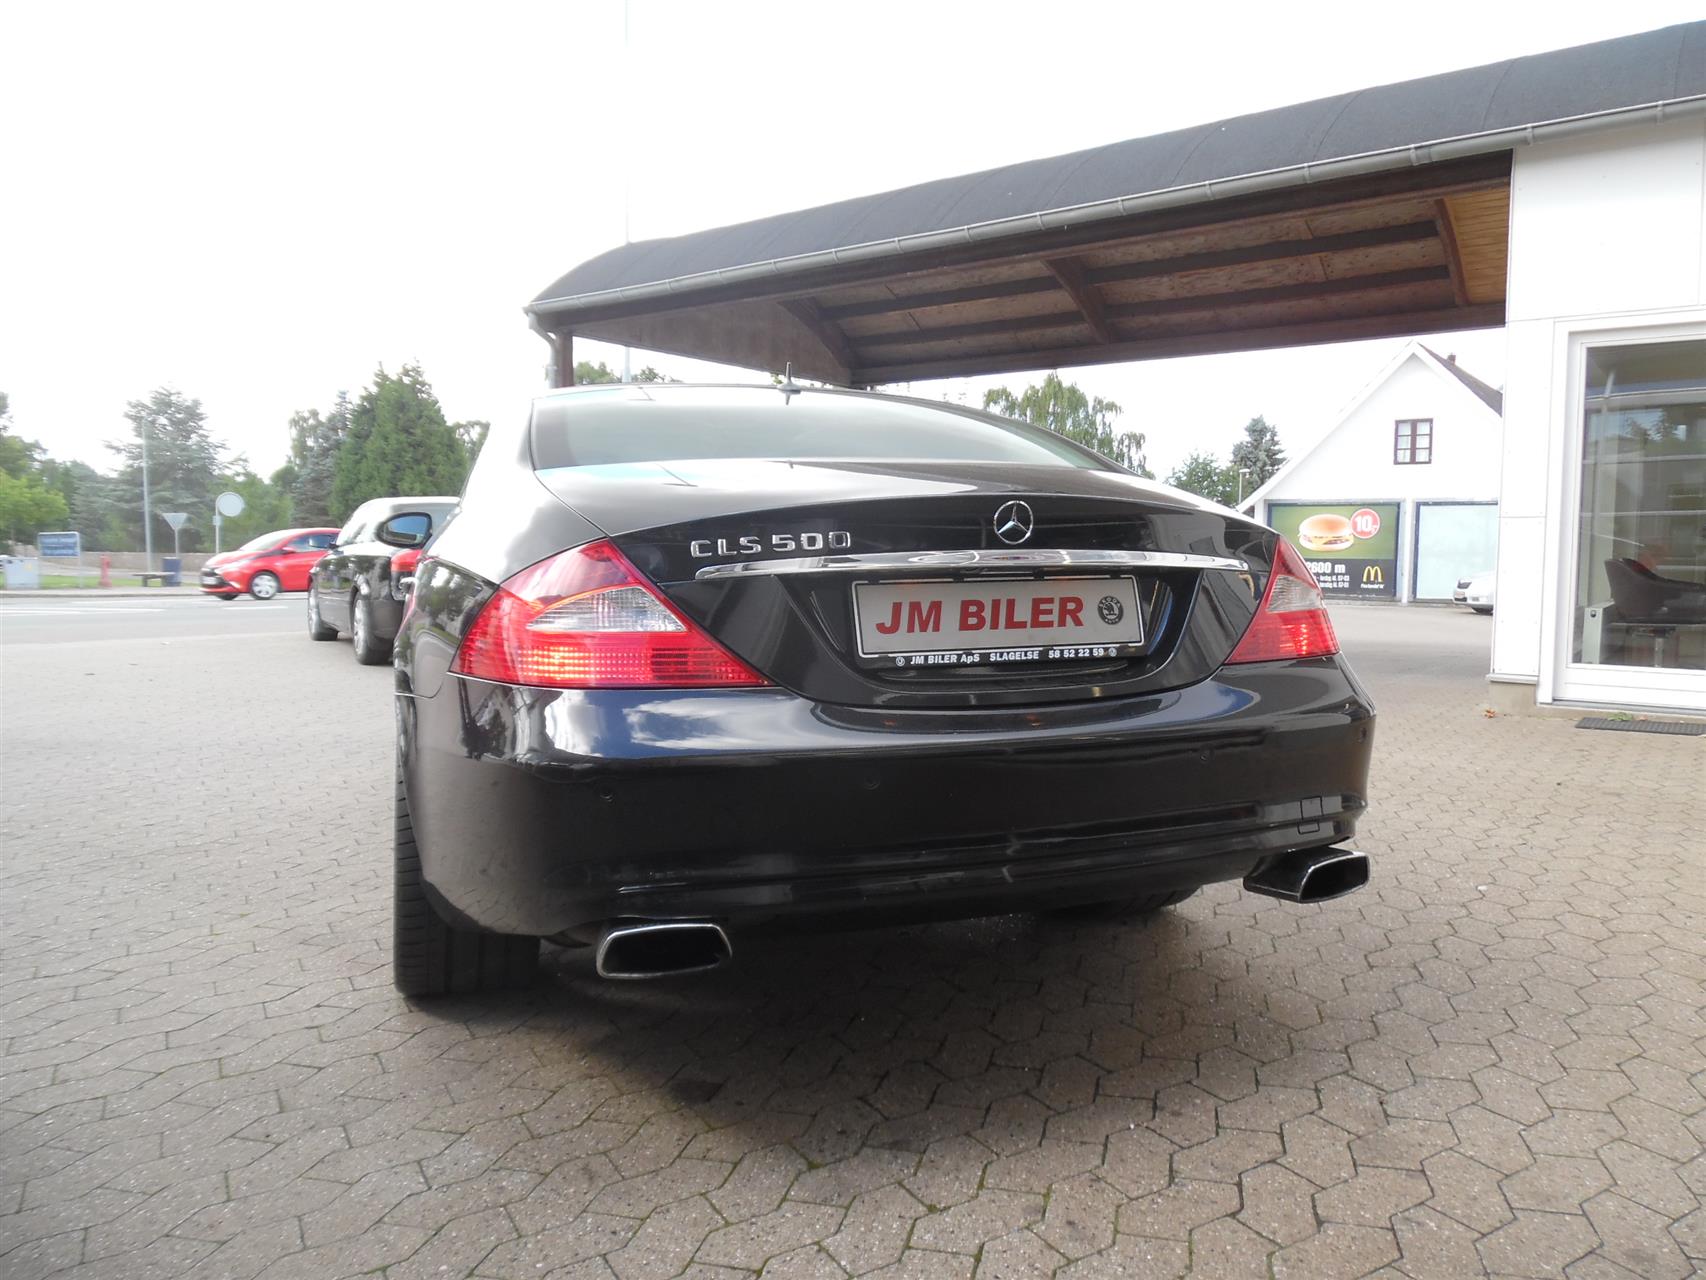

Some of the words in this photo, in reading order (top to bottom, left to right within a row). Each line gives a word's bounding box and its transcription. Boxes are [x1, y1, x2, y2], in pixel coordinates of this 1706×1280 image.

[690, 536, 762, 558] CLS
[771, 531, 851, 552] 500
[1334, 564, 1346, 573] m
[875, 600, 942, 635] JM
[958, 596, 1084, 631] BILER
[910, 655, 924, 665] JM
[927, 654, 958, 664] BILER
[960, 653, 980, 664] ApS
[989, 651, 1039, 661] SLAGELSE
[1048, 650, 1060, 658] 58
[1063, 649, 1075, 658] 52
[1078, 648, 1090, 657] 22
[1092, 648, 1104, 656] 59
